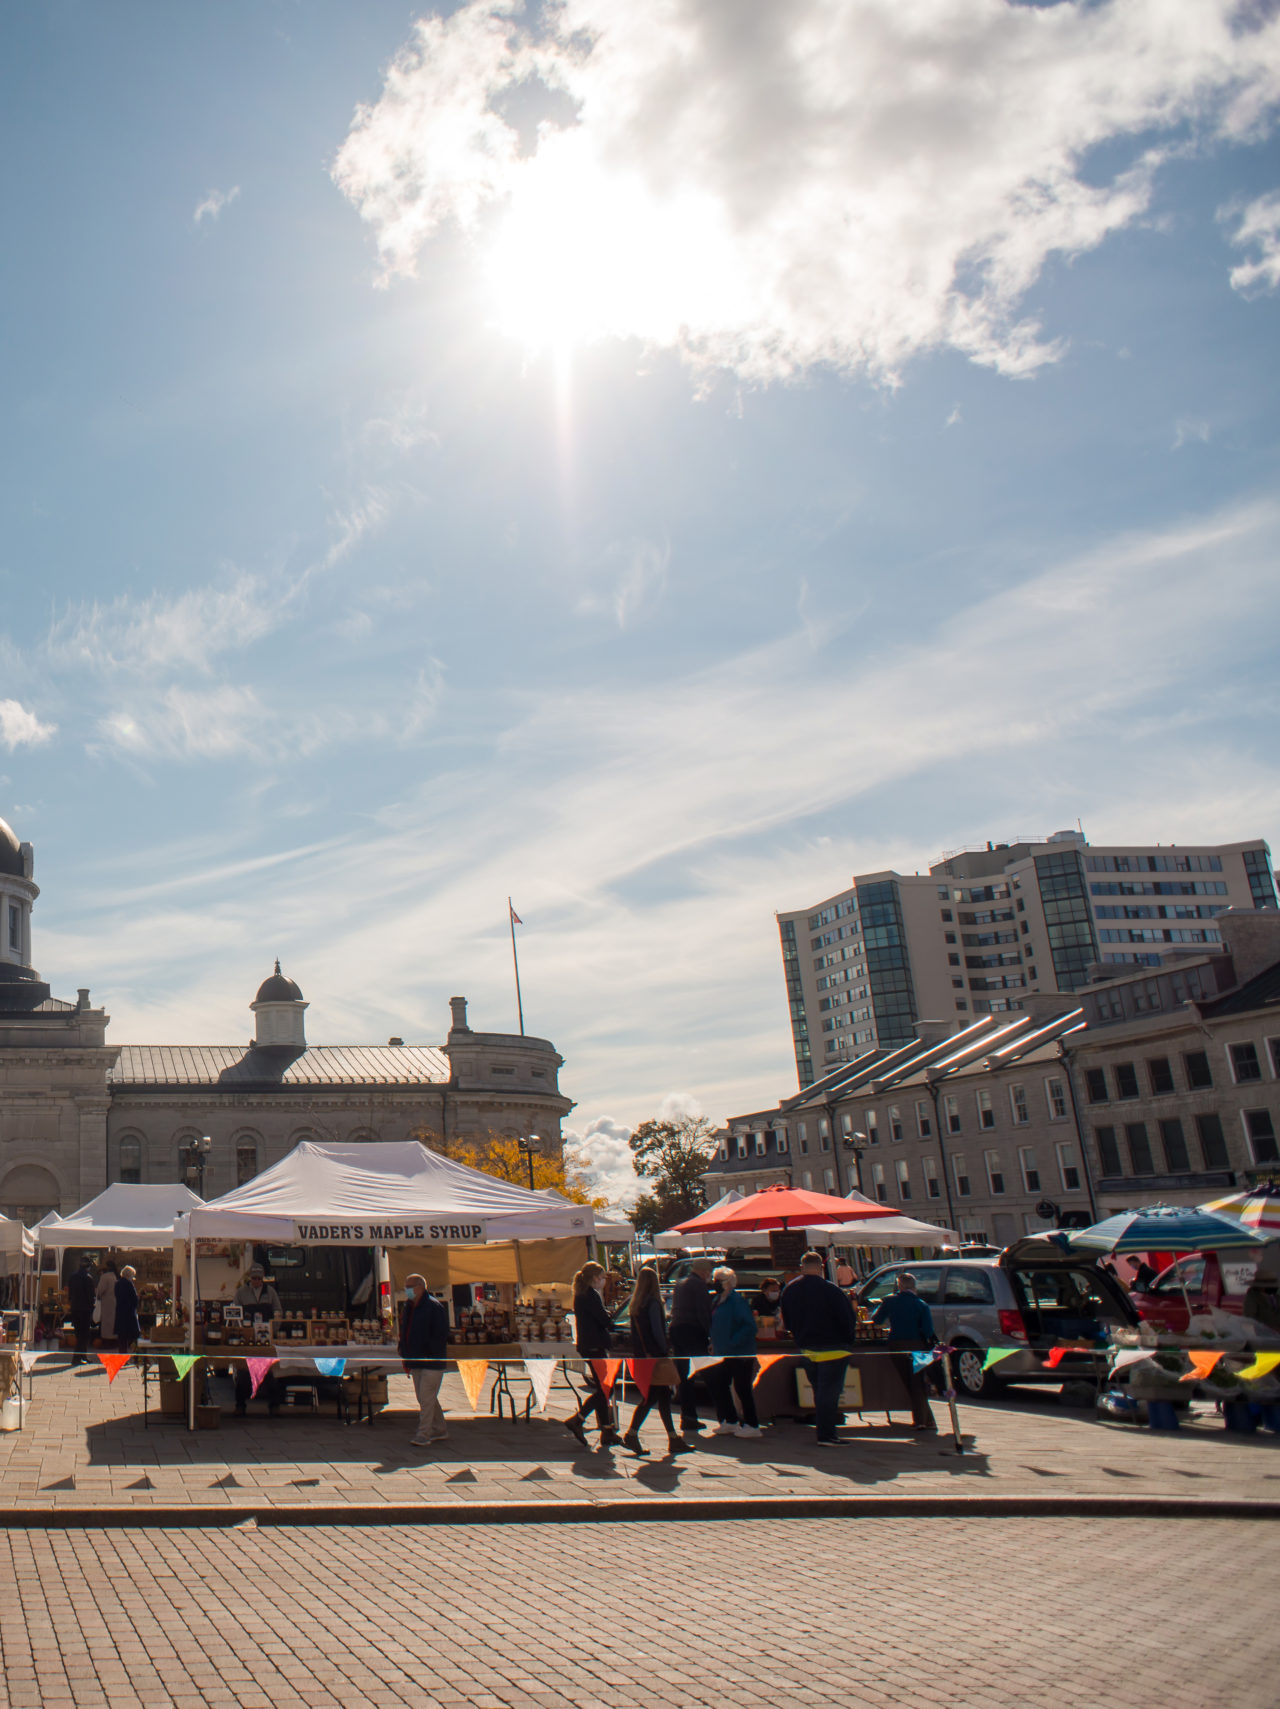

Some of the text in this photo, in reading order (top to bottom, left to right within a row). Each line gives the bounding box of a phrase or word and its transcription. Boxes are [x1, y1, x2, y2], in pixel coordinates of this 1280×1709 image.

[297, 1225, 482, 1239] VADER'S MAPLE SYRUP
